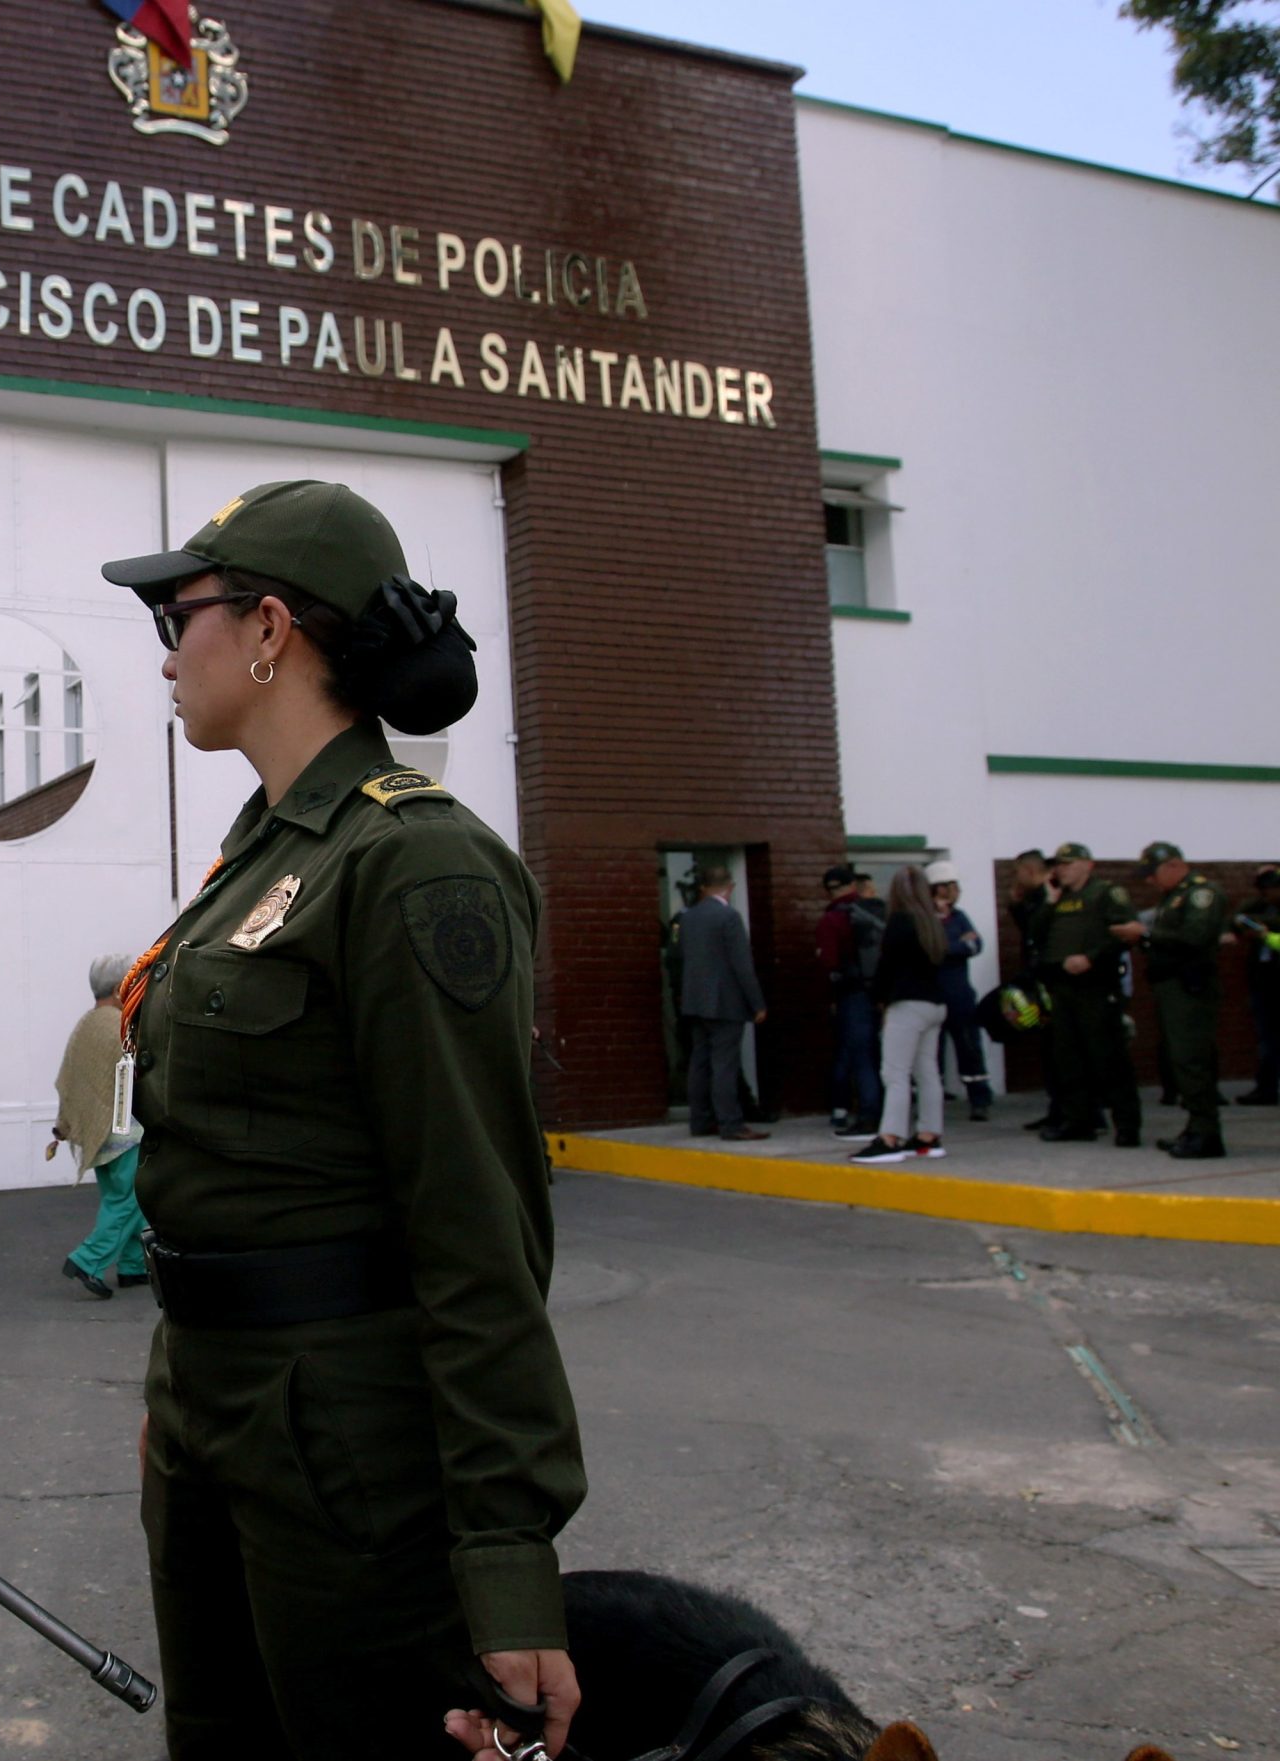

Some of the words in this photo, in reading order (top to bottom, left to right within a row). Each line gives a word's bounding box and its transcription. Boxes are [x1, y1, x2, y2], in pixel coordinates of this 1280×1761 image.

[53, 173, 335, 273] CADETES
[351, 217, 422, 285] DE
[437, 232, 648, 319] POLICIA
[188, 294, 263, 363] DE
[279, 305, 464, 388] PAULA
[480, 332, 776, 429] SANTANDER
